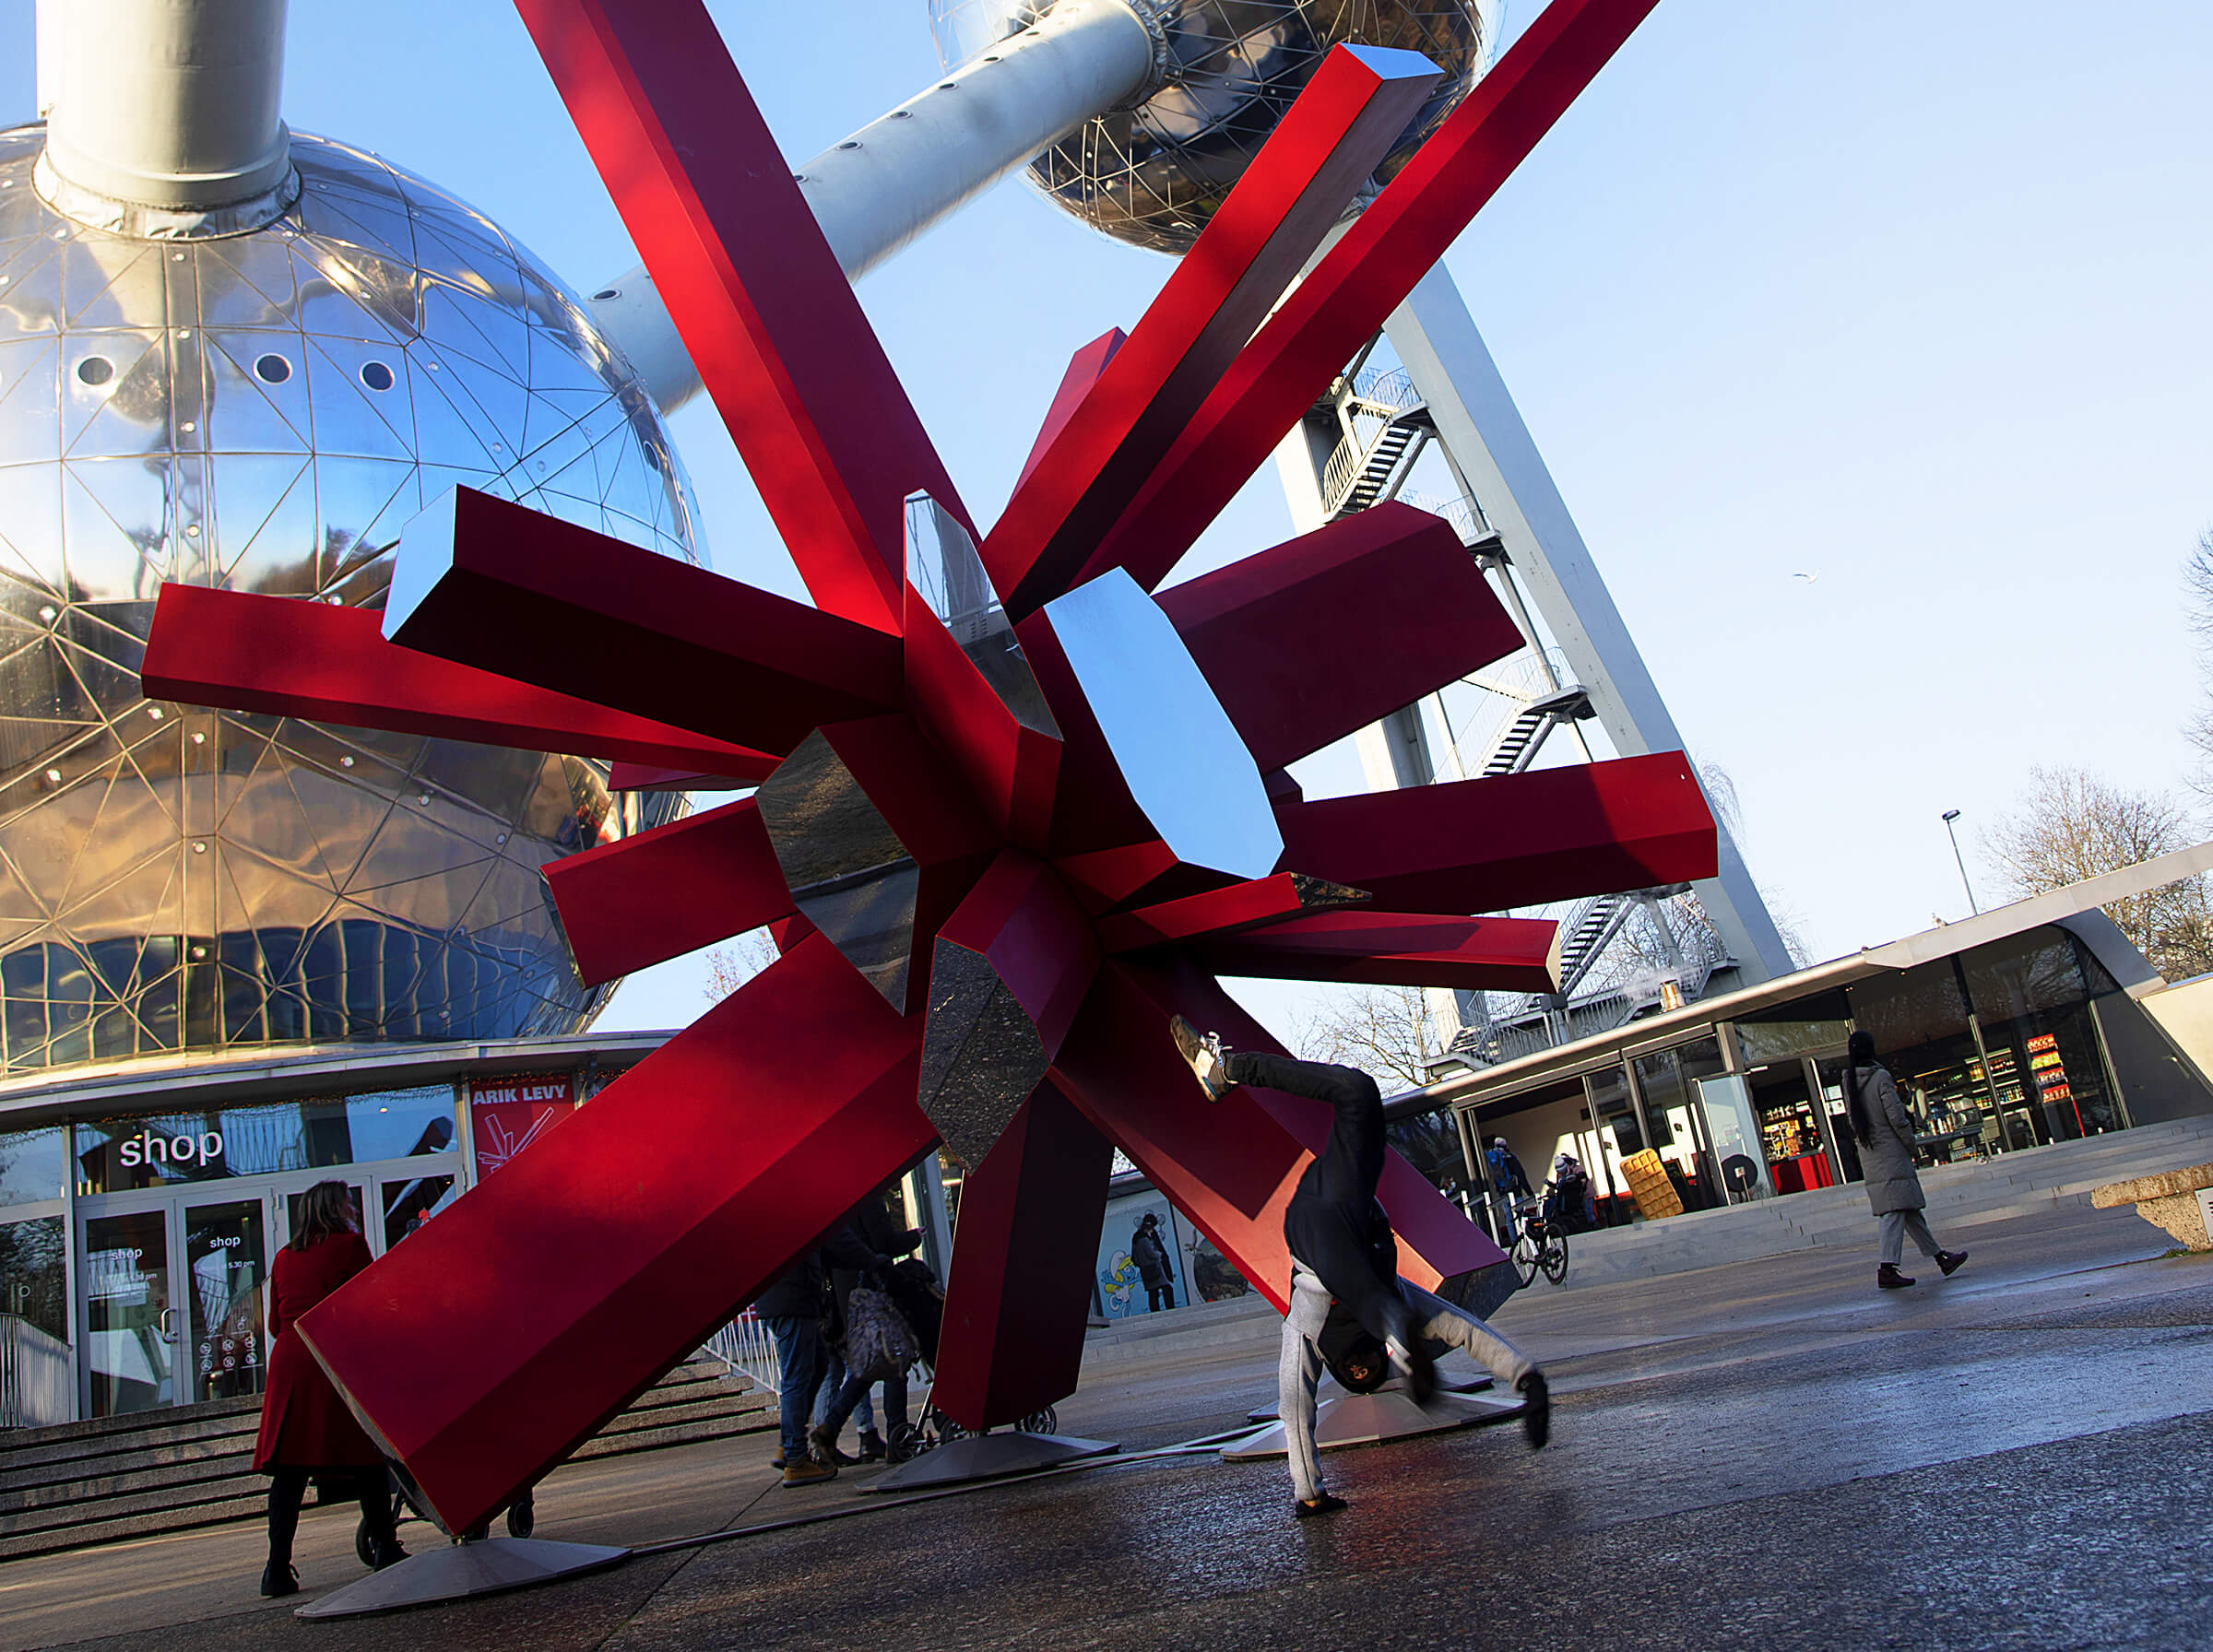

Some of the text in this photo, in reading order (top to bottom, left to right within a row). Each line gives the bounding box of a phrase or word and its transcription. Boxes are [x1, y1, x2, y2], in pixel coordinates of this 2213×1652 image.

[472, 1084, 565, 1105] ARIK LEVY
[120, 1129, 223, 1167] shop
[209, 1236, 241, 1248] shop
[111, 1248, 143, 1260] shop
